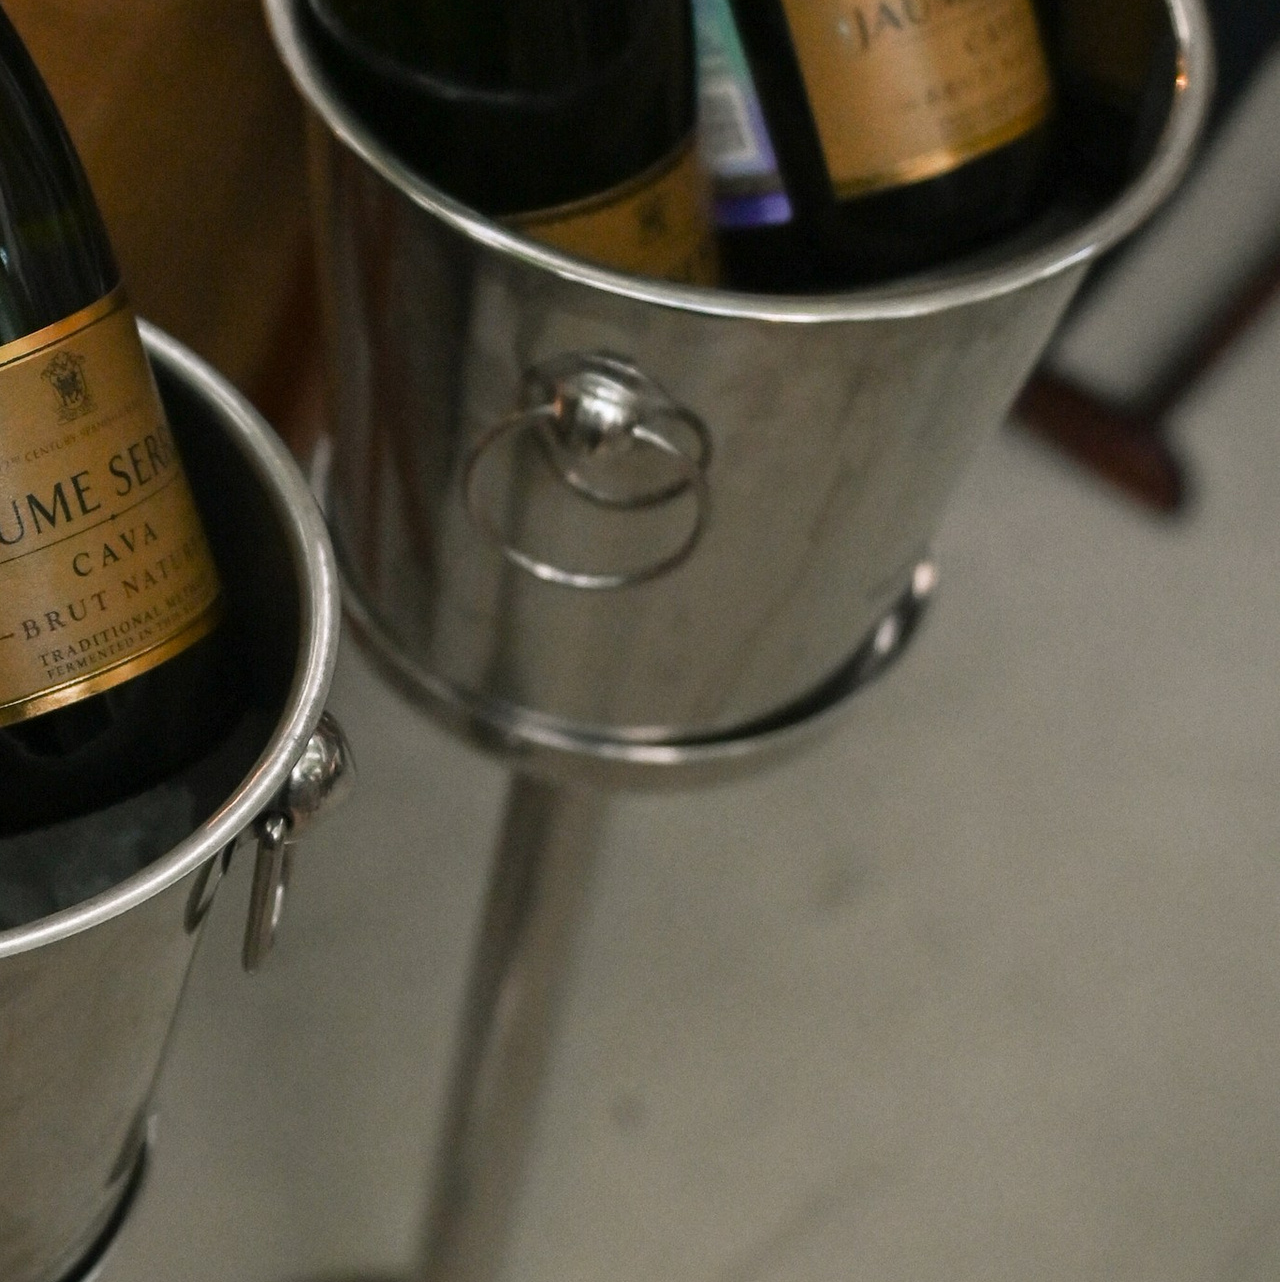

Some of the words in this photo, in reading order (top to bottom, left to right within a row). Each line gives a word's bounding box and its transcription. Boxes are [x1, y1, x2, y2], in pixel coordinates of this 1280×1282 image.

[107, 425, 172, 498] SERR
[71, 522, 158, 578] CAVA
[21, 590, 107, 642] BRUT
[37, 603, 164, 668] TRADITIONAL
[46, 636, 135, 680] FERMENTED
[138, 628, 153, 643] IN
